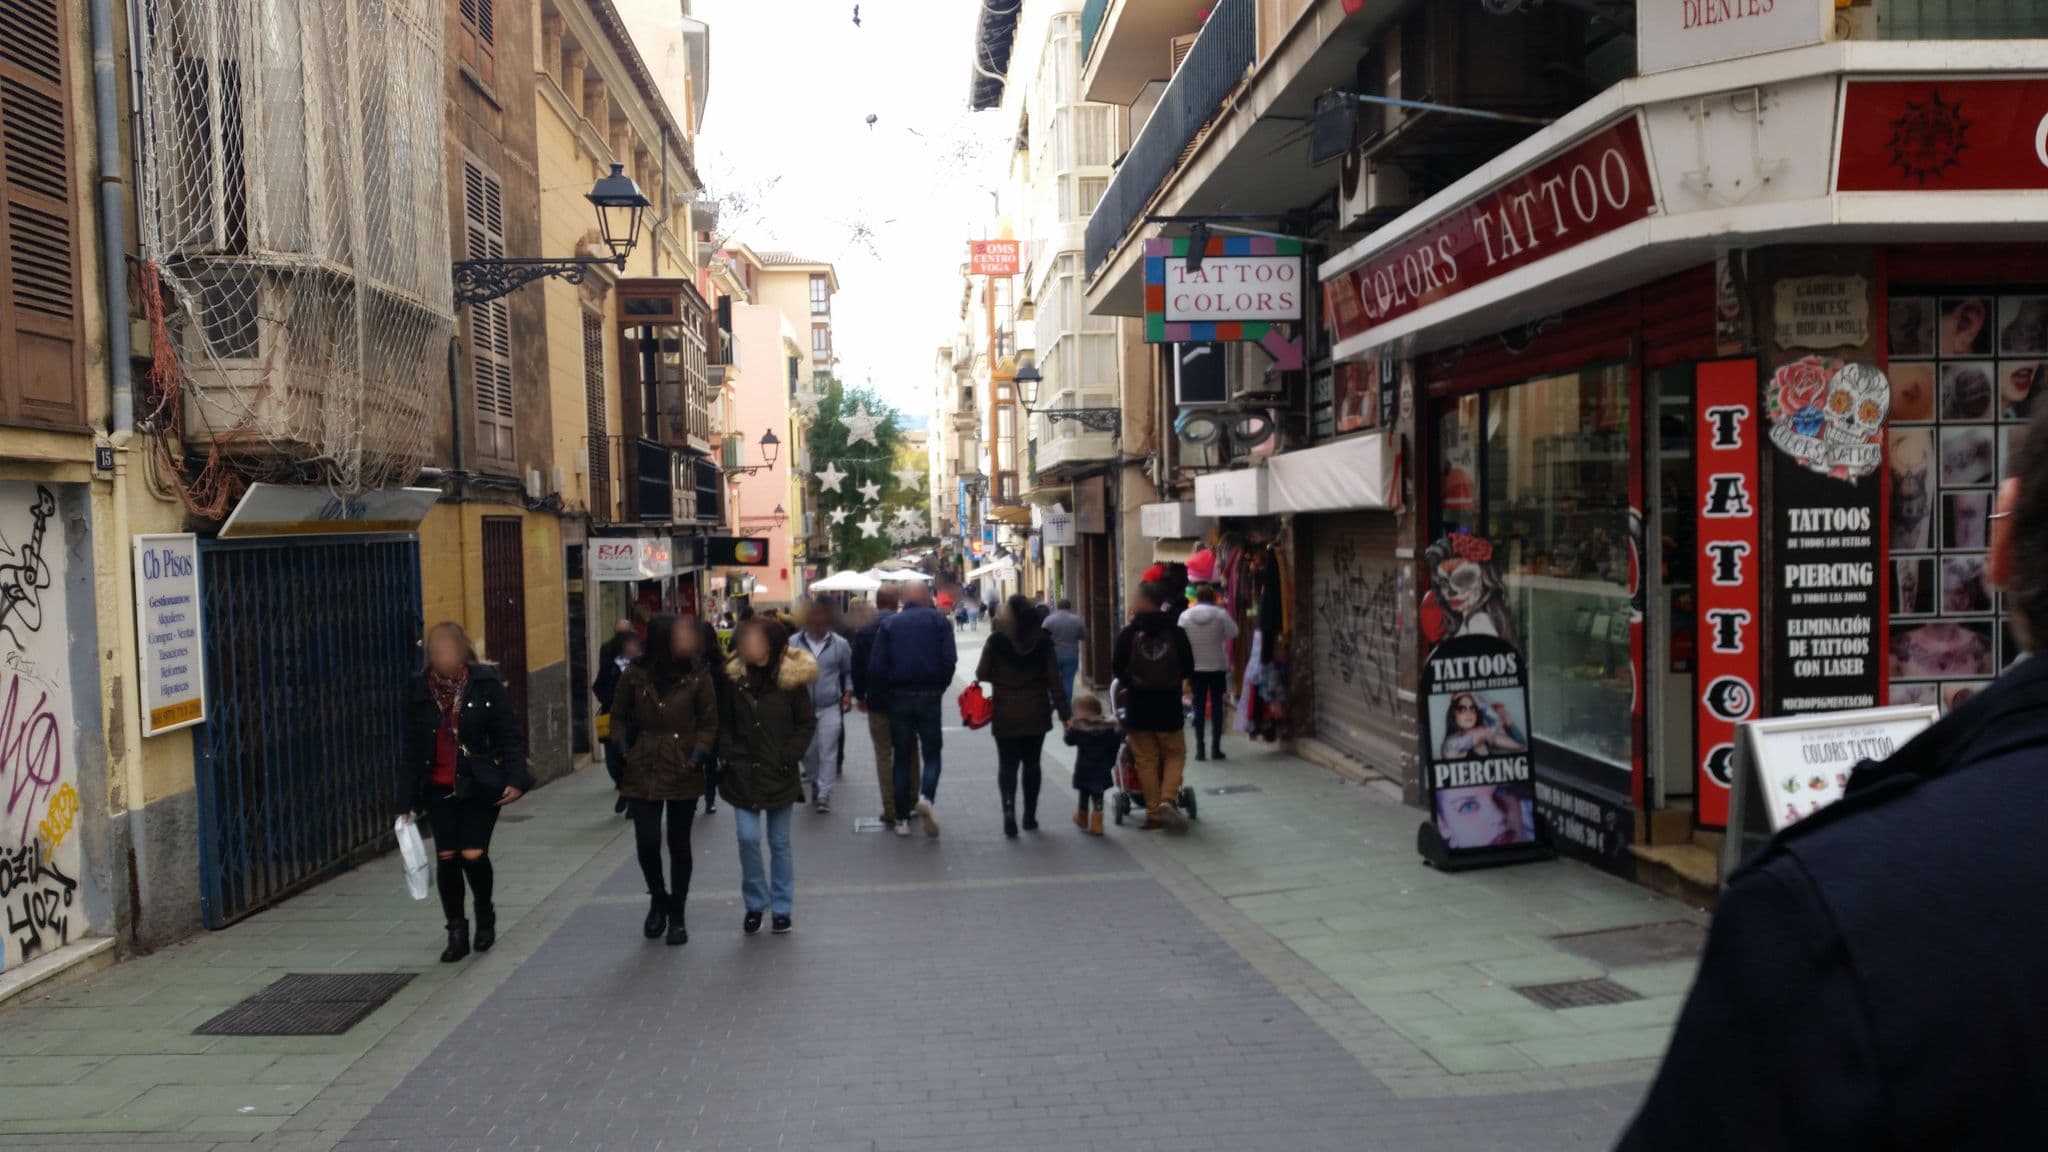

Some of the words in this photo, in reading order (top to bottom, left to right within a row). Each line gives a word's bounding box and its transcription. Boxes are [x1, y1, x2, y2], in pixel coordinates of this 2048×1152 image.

[1360, 235, 1457, 318] COLORS
[1474, 148, 1630, 267] TATTOO
[980, 263, 1010, 272] YOGA
[1173, 263, 1294, 284] TATTOO
[1174, 292, 1294, 312] COLORS
[101, 450, 111, 466] 15
[1788, 507, 1871, 532] TATTOOS
[1827, 537, 1841, 548] LOS
[143, 548, 160, 580] Cb
[162, 549, 193, 578] Pisos
[1784, 562, 1873, 588] PIERCING
[1787, 613, 1871, 637] ELIMINACIÓN
[1789, 639, 1808, 658] DE
[1811, 638, 1870, 656] TATTOOS
[1431, 652, 1517, 681] TATTOOS
[1794, 659, 1821, 678] CON
[1824, 658, 1865, 676] LASER
[1782, 694, 1874, 711] MICROPIGMENTACIÓN
[1802, 742, 1848, 764] COLORS
[1848, 736, 1895, 761] TATTOO
[1435, 756, 1529, 788] PIERCING
